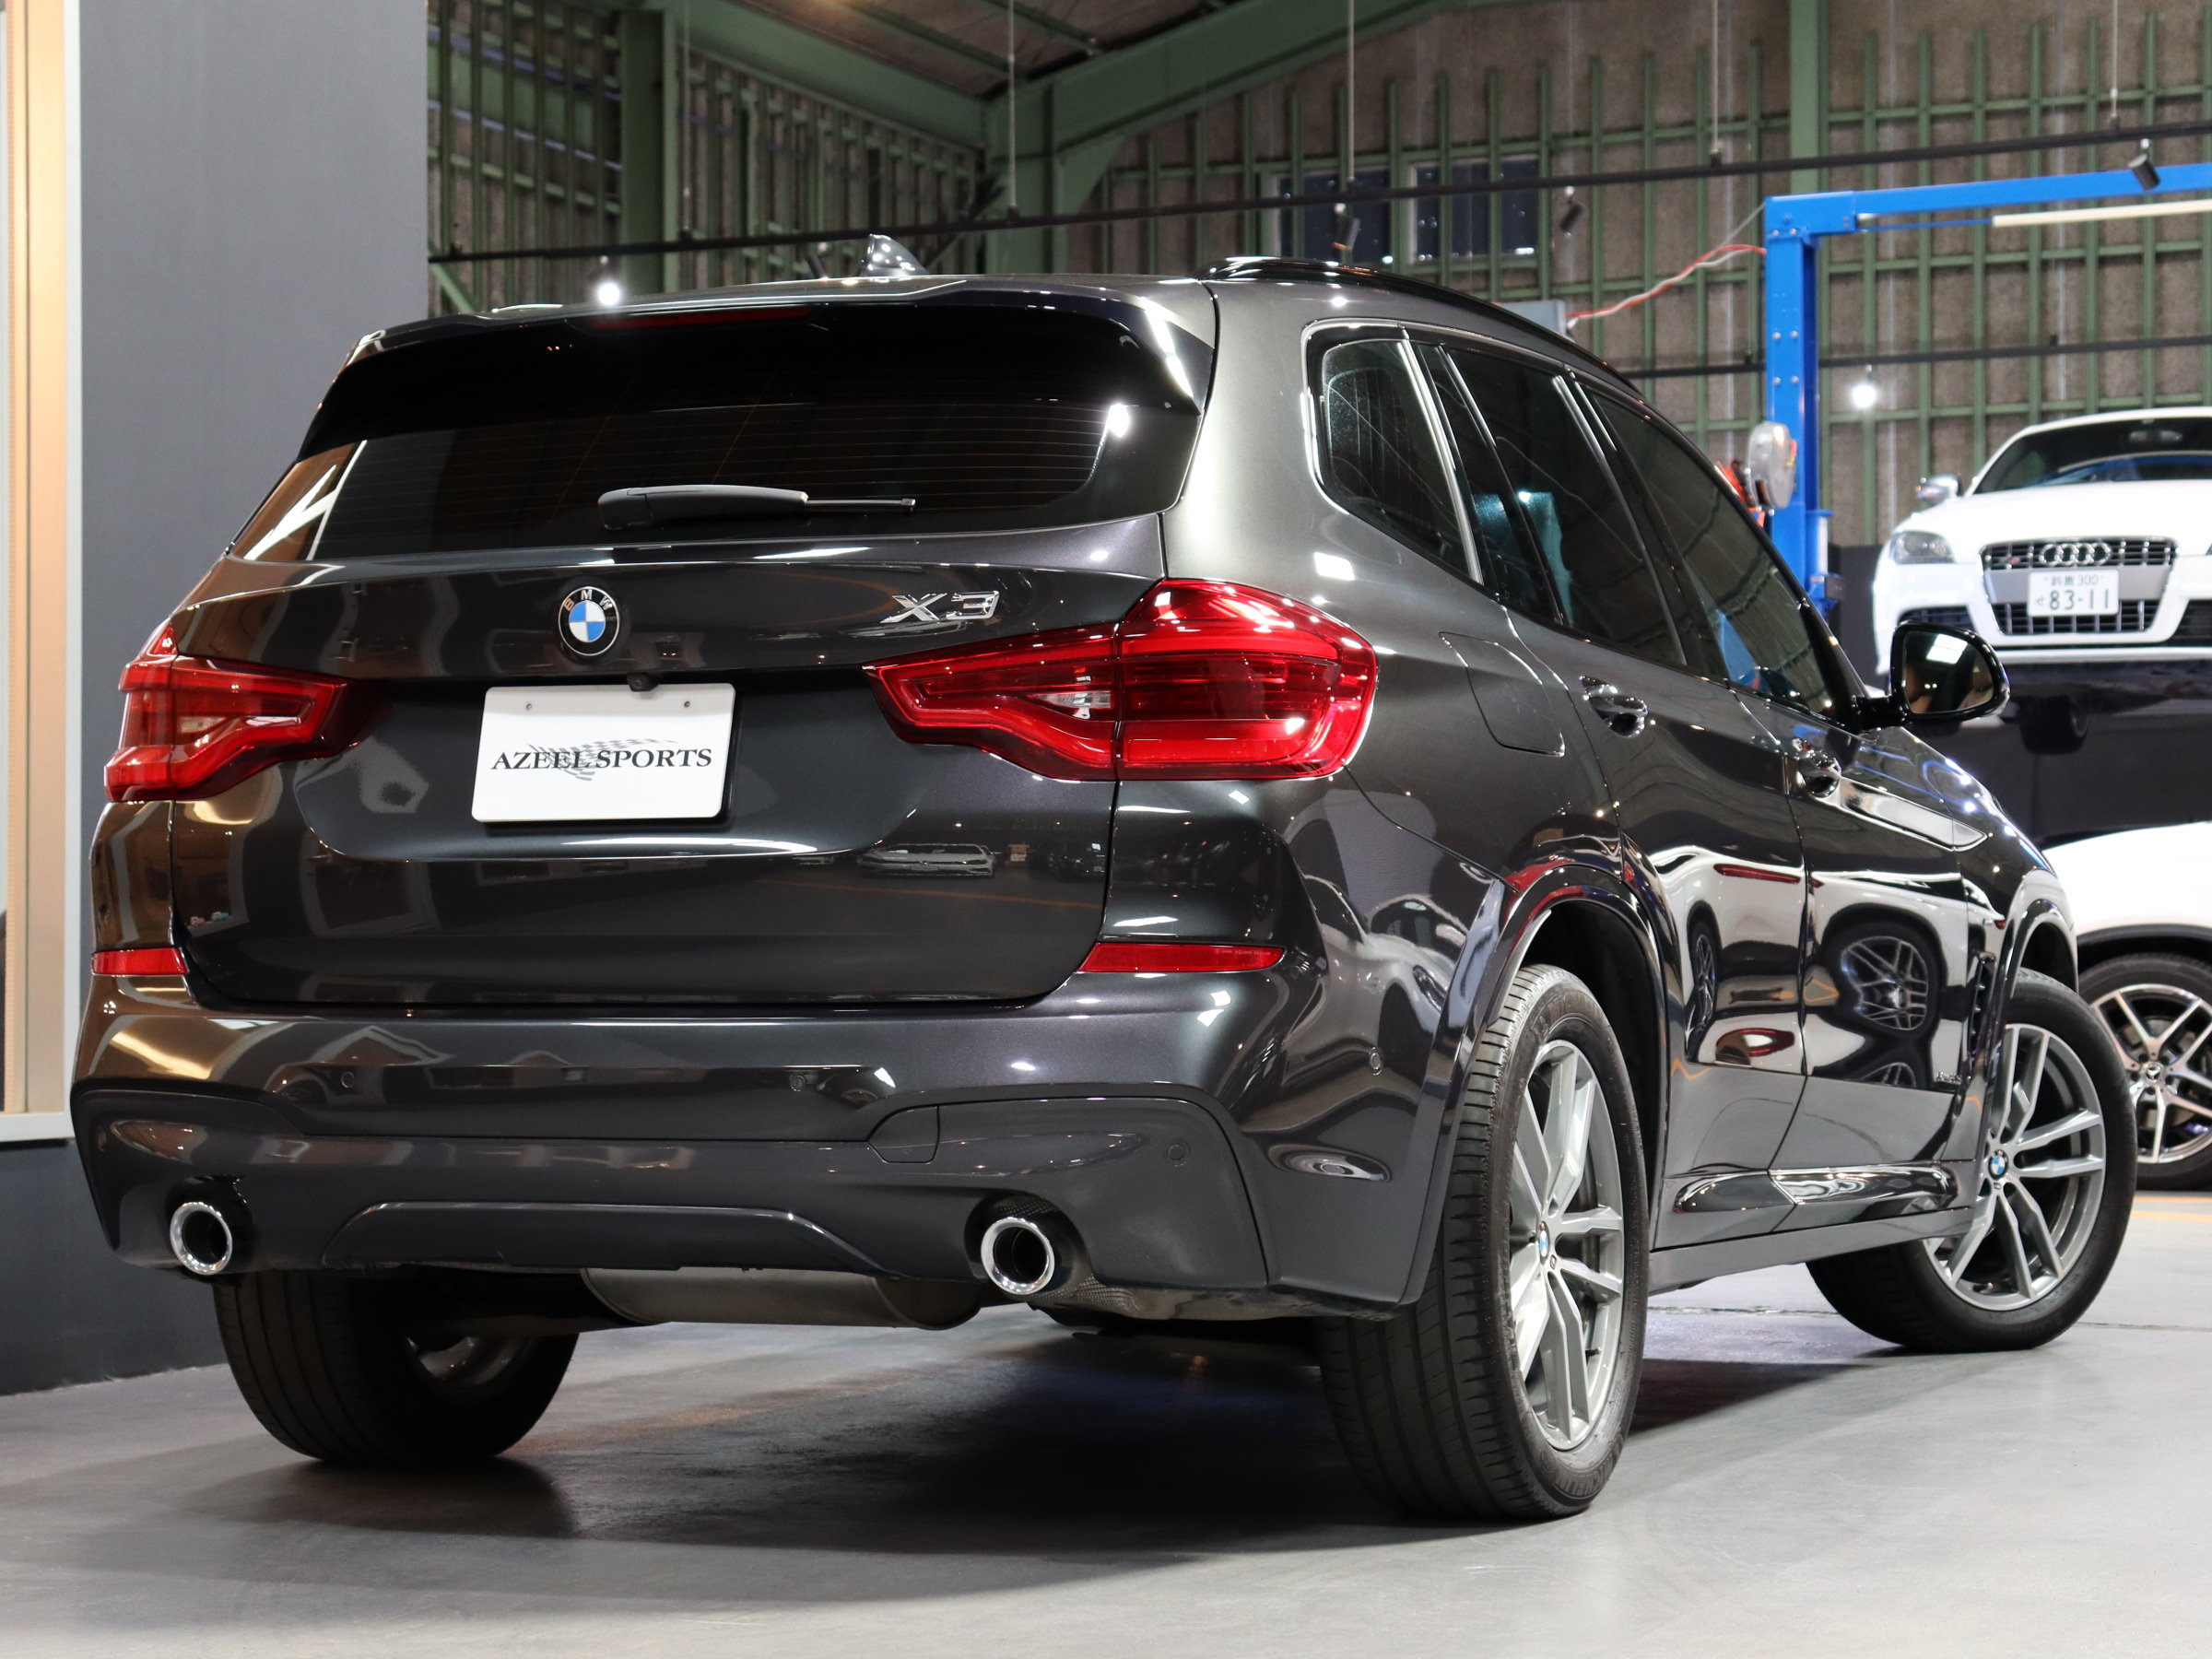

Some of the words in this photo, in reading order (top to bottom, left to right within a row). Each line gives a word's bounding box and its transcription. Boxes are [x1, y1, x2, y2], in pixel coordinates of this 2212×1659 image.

[563, 589, 613, 612] BMW
[879, 591, 1000, 623] X3
[2049, 588, 2109, 610] 83-11
[490, 751, 590, 770] AZEEL
[595, 748, 712, 769] SPORTS
